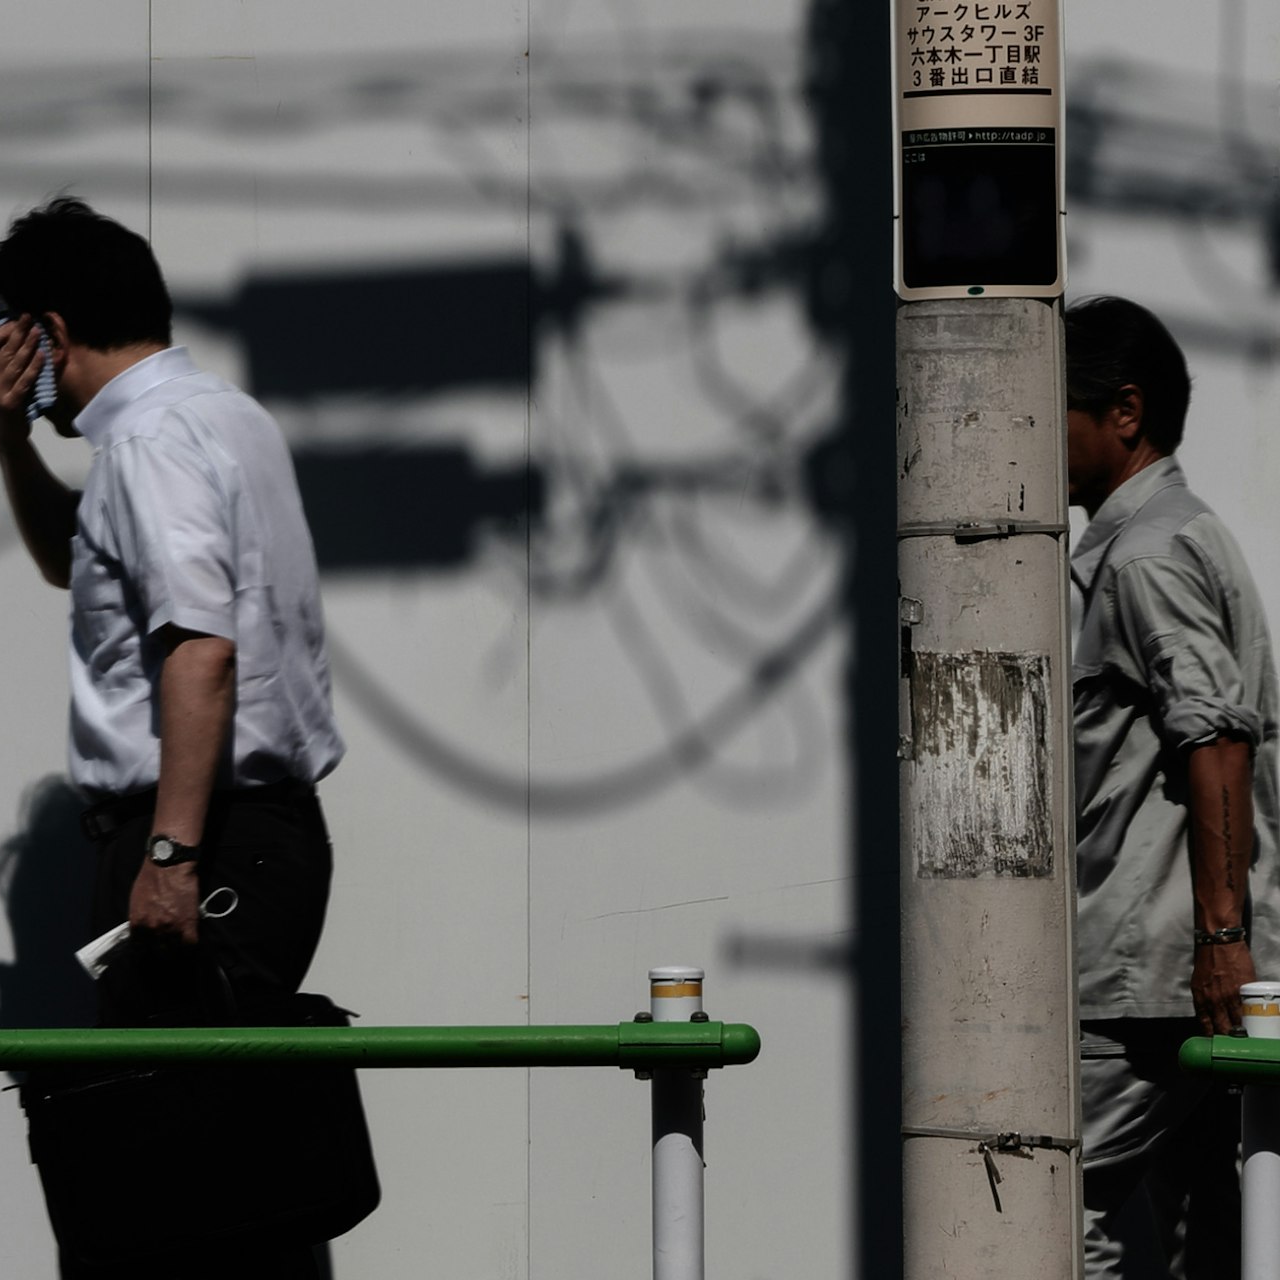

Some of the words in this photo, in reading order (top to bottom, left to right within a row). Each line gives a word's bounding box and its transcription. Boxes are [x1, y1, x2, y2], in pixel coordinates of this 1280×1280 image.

[916, 2, 1031, 23] アークヒルズ
[907, 25, 1017, 45] サウスタワー
[1024, 25, 1045, 42] 3F
[911, 45, 1041, 66] 六本木一丁目駅
[913, 67, 1040, 87] 3番出口直結
